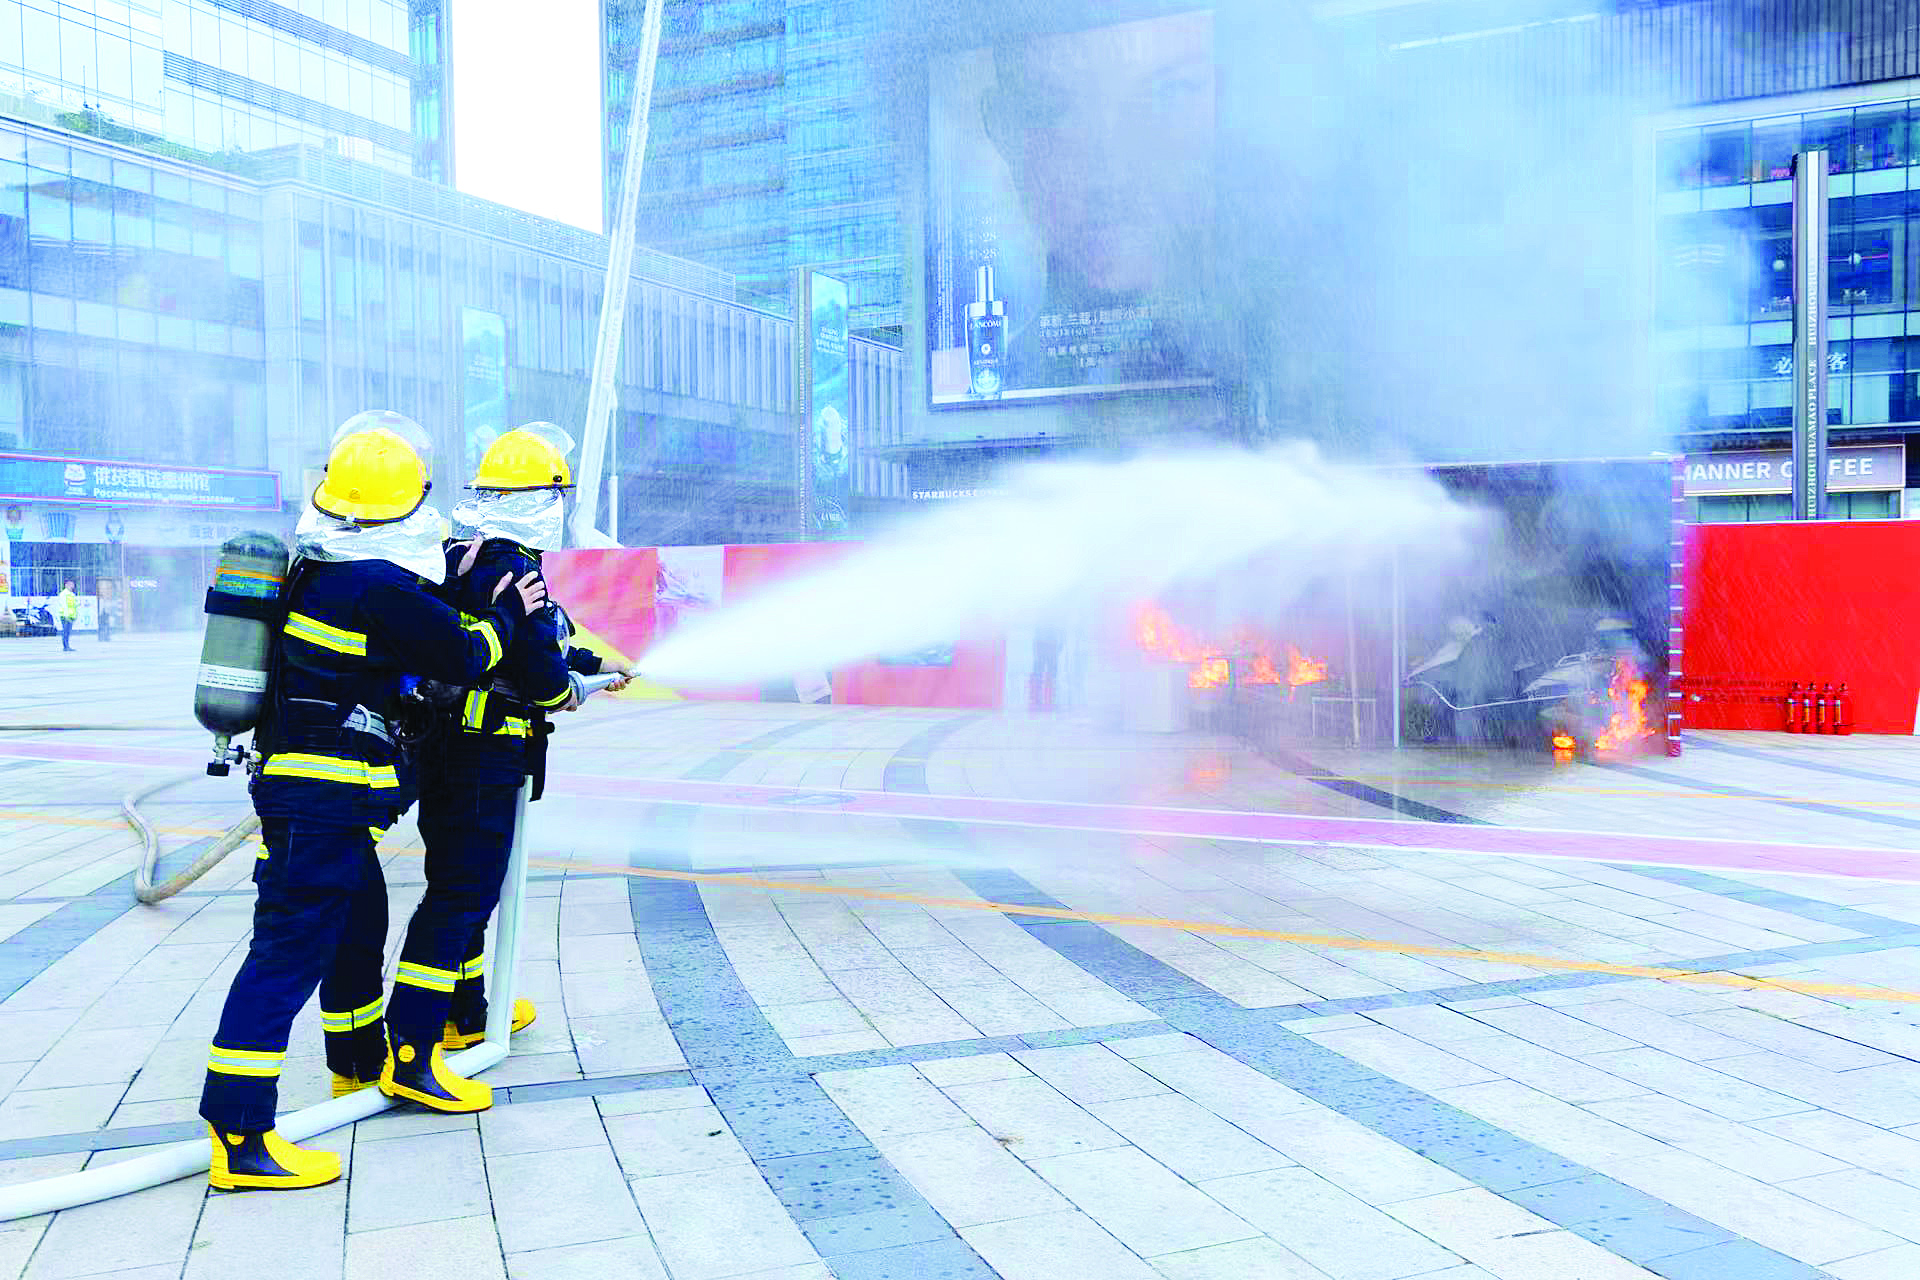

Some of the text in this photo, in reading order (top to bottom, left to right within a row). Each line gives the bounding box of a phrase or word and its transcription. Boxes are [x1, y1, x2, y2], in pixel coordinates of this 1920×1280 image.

[1772, 352, 1849, 374] 必客
[1807, 359, 1817, 519] HUIZHOU HUAMAO PLACE
[1780, 457, 1873, 478] CFEE
[912, 489, 972, 500] STARBUCKS
